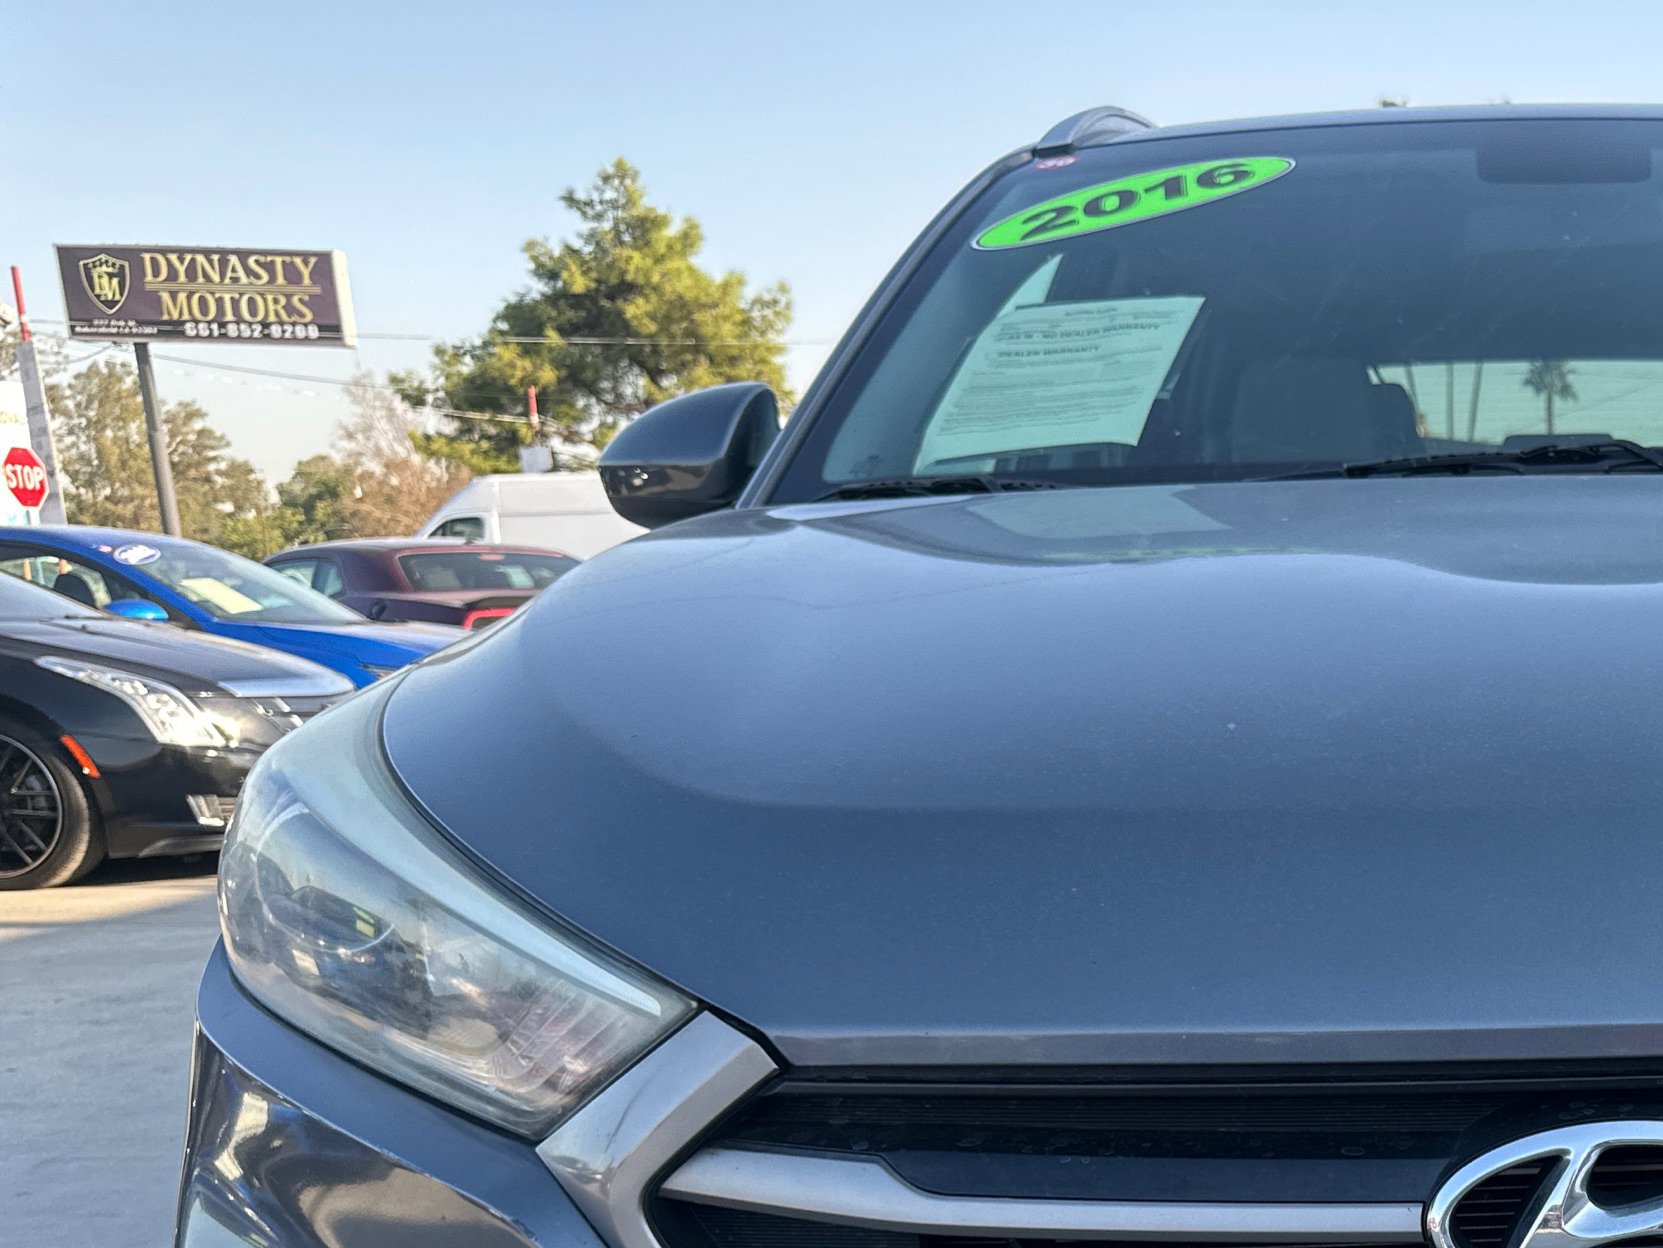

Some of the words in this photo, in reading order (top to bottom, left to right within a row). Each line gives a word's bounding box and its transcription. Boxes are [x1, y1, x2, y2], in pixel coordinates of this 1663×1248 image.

[1020, 163, 1255, 241] 2016
[140, 252, 318, 286] DYNASTY
[158, 291, 314, 323] MOTORS
[5, 463, 45, 491] STOP
